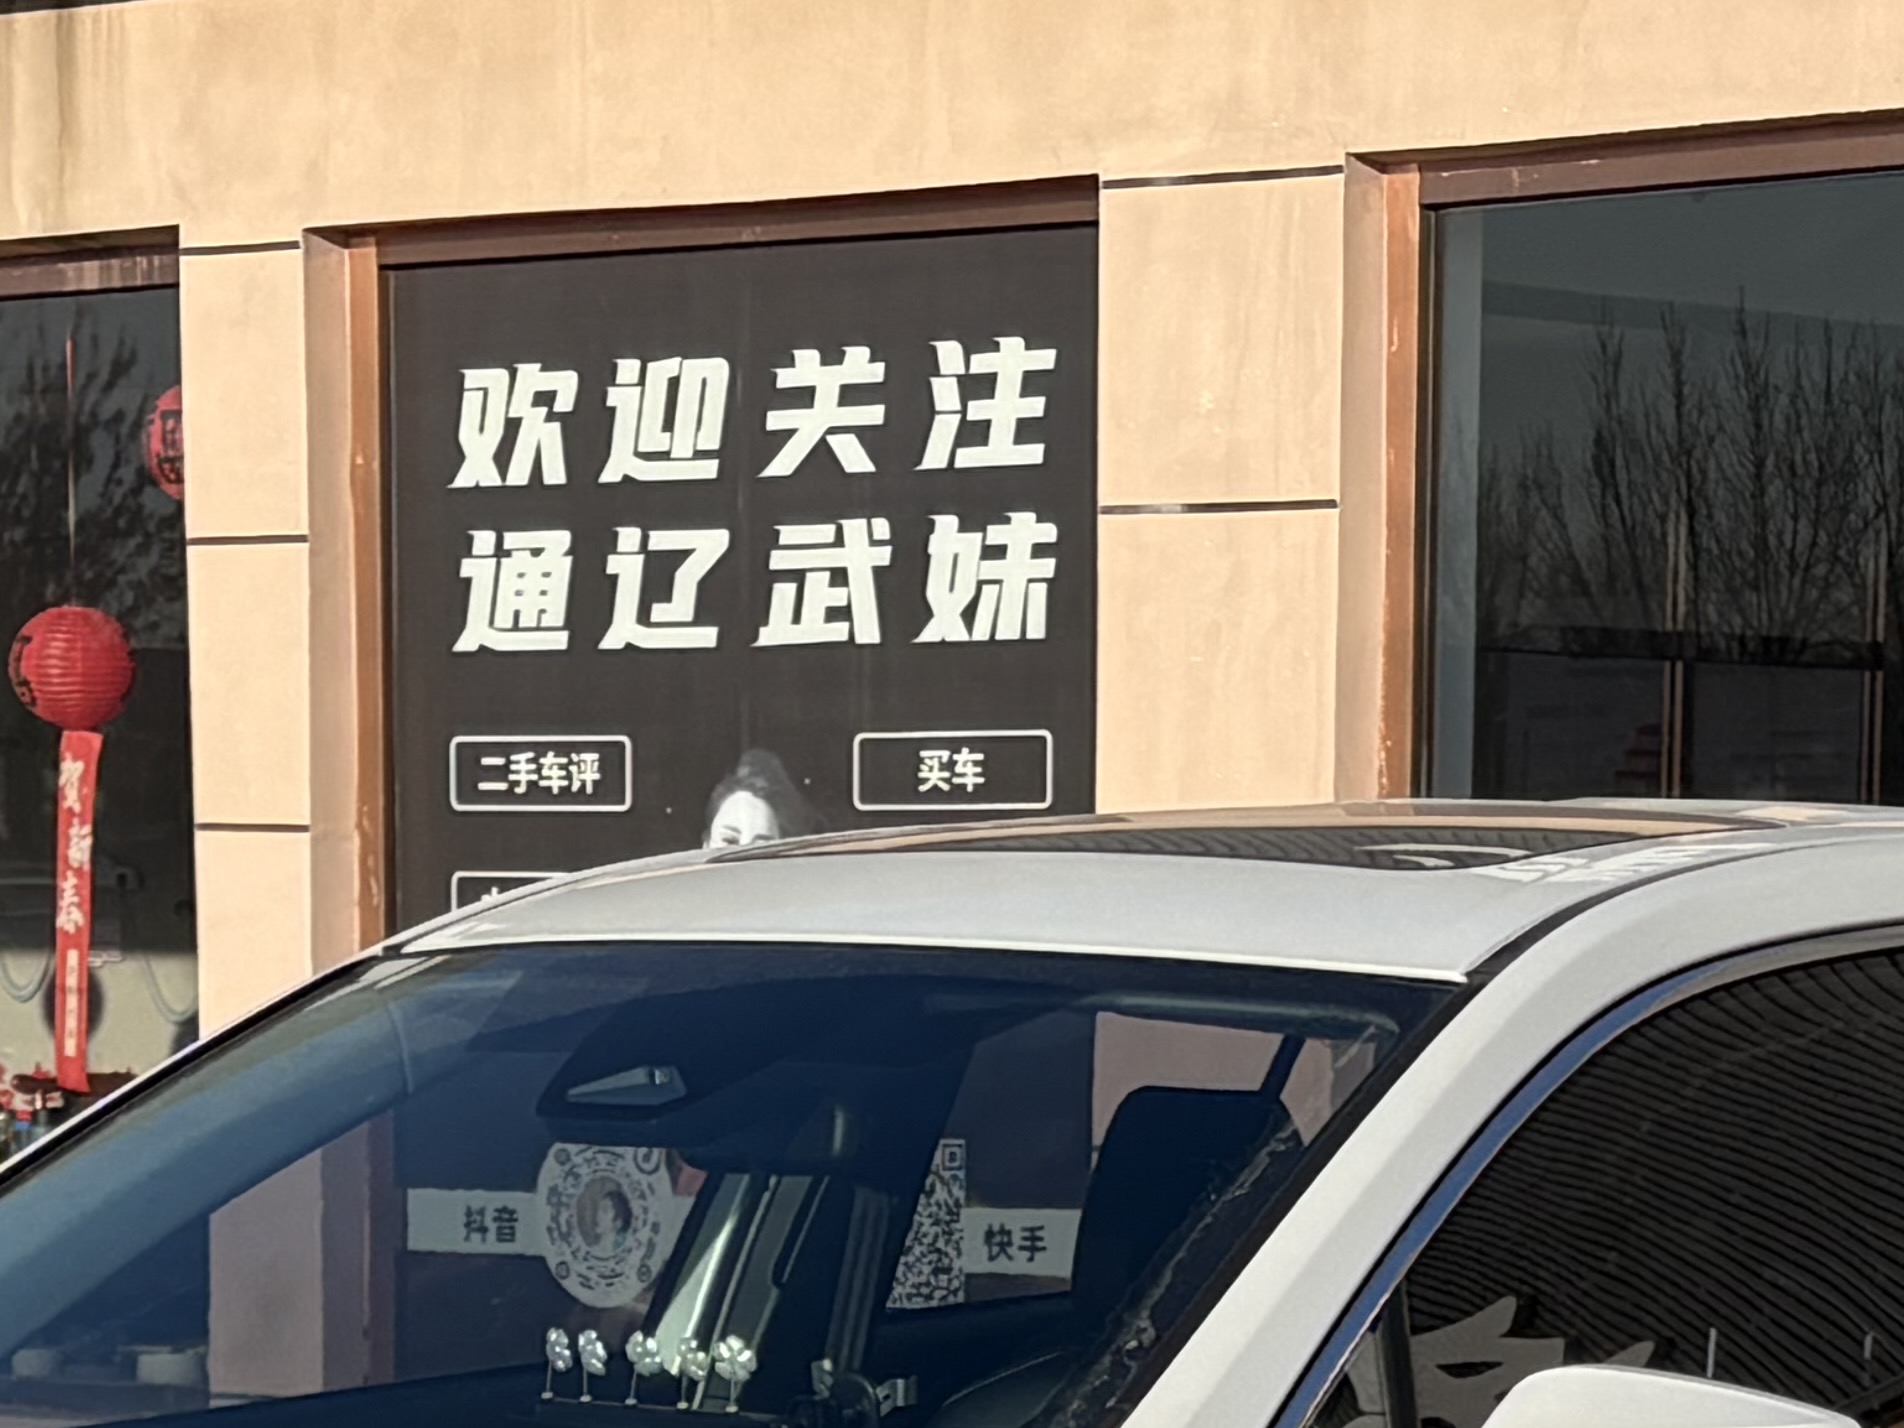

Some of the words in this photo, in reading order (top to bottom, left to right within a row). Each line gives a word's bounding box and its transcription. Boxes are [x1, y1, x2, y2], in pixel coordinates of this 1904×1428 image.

[447, 336, 1058, 489] 欢迎关注
[450, 511, 1059, 653] 通辽武妹
[477, 751, 602, 795] 二手车评
[917, 748, 986, 793] 买车
[56, 752, 93, 935] 贺新春
[462, 1205, 519, 1244] 抖音
[983, 1222, 1048, 1263] 快手
